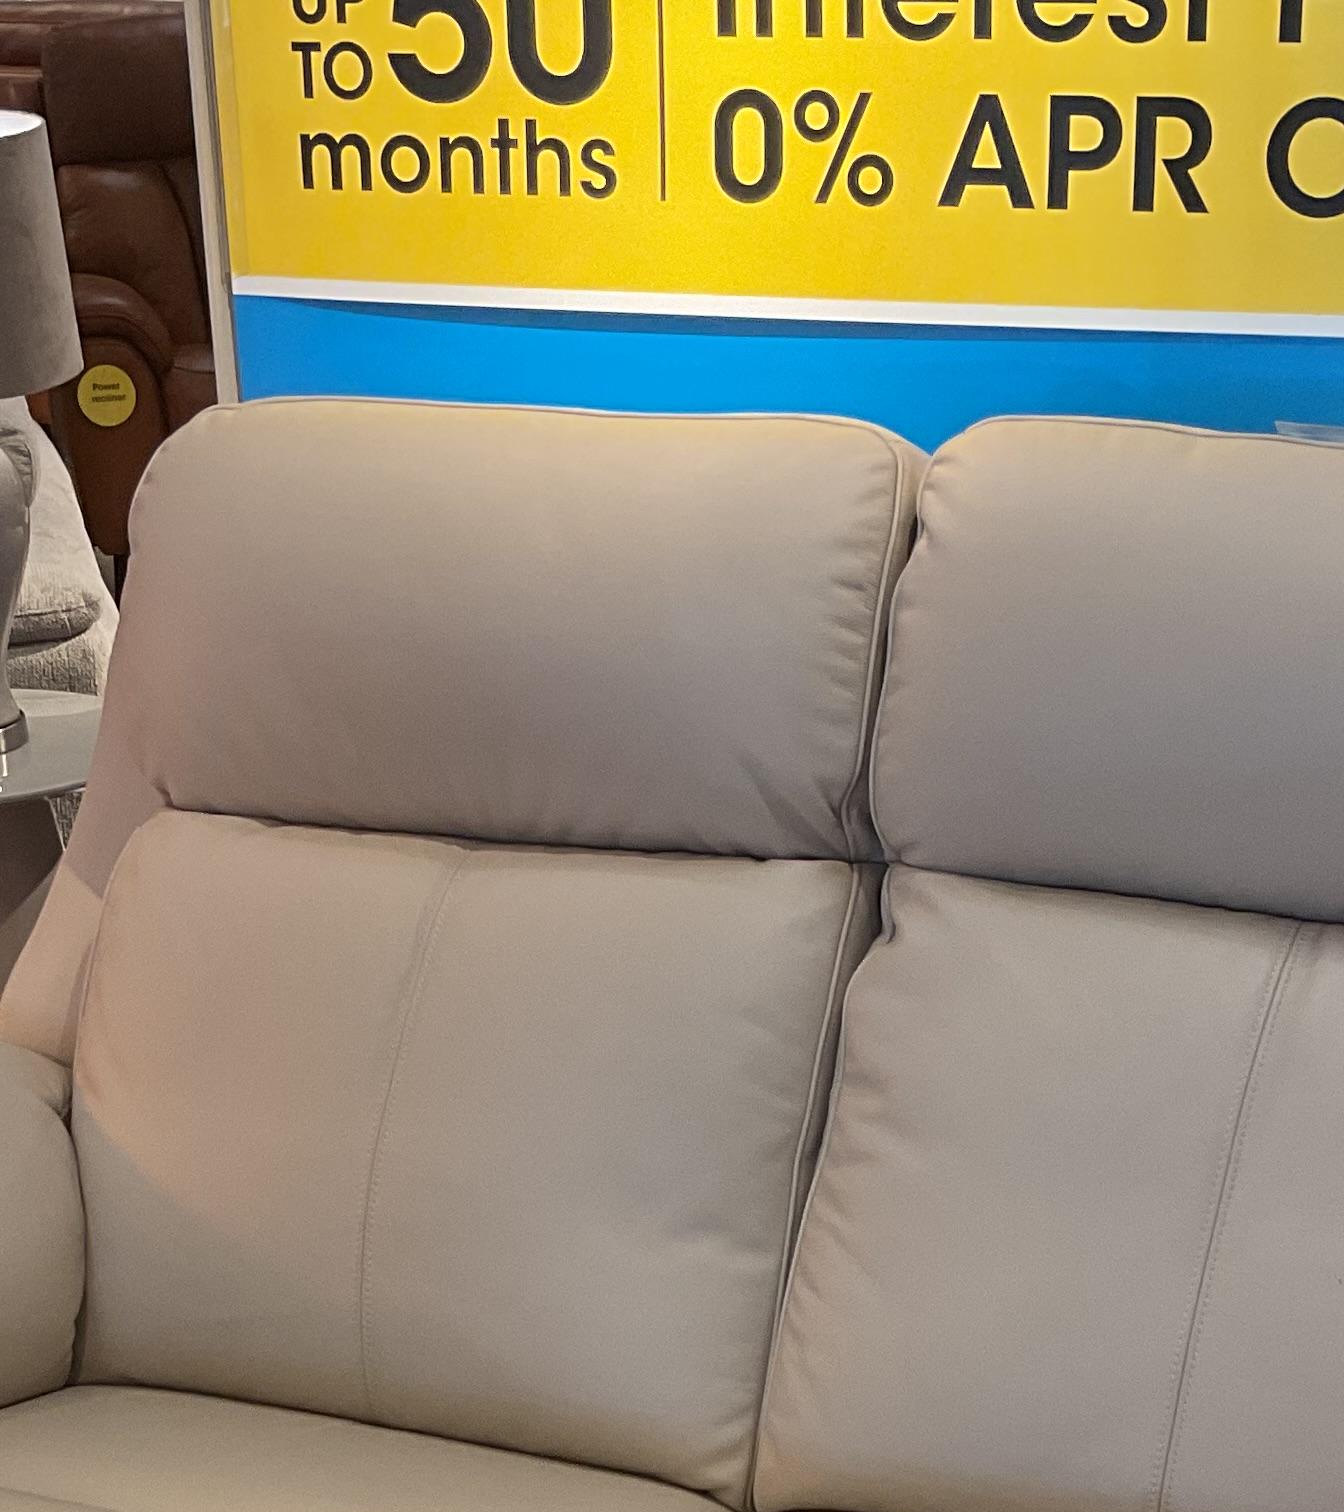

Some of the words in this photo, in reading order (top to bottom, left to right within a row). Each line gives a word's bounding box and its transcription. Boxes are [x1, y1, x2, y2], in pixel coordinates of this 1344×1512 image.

[291, 41, 373, 100] TO
[387, 0, 613, 106] 50
[299, 118, 617, 199] months
[713, 88, 894, 207] 0%
[937, 94, 1213, 214] APR
